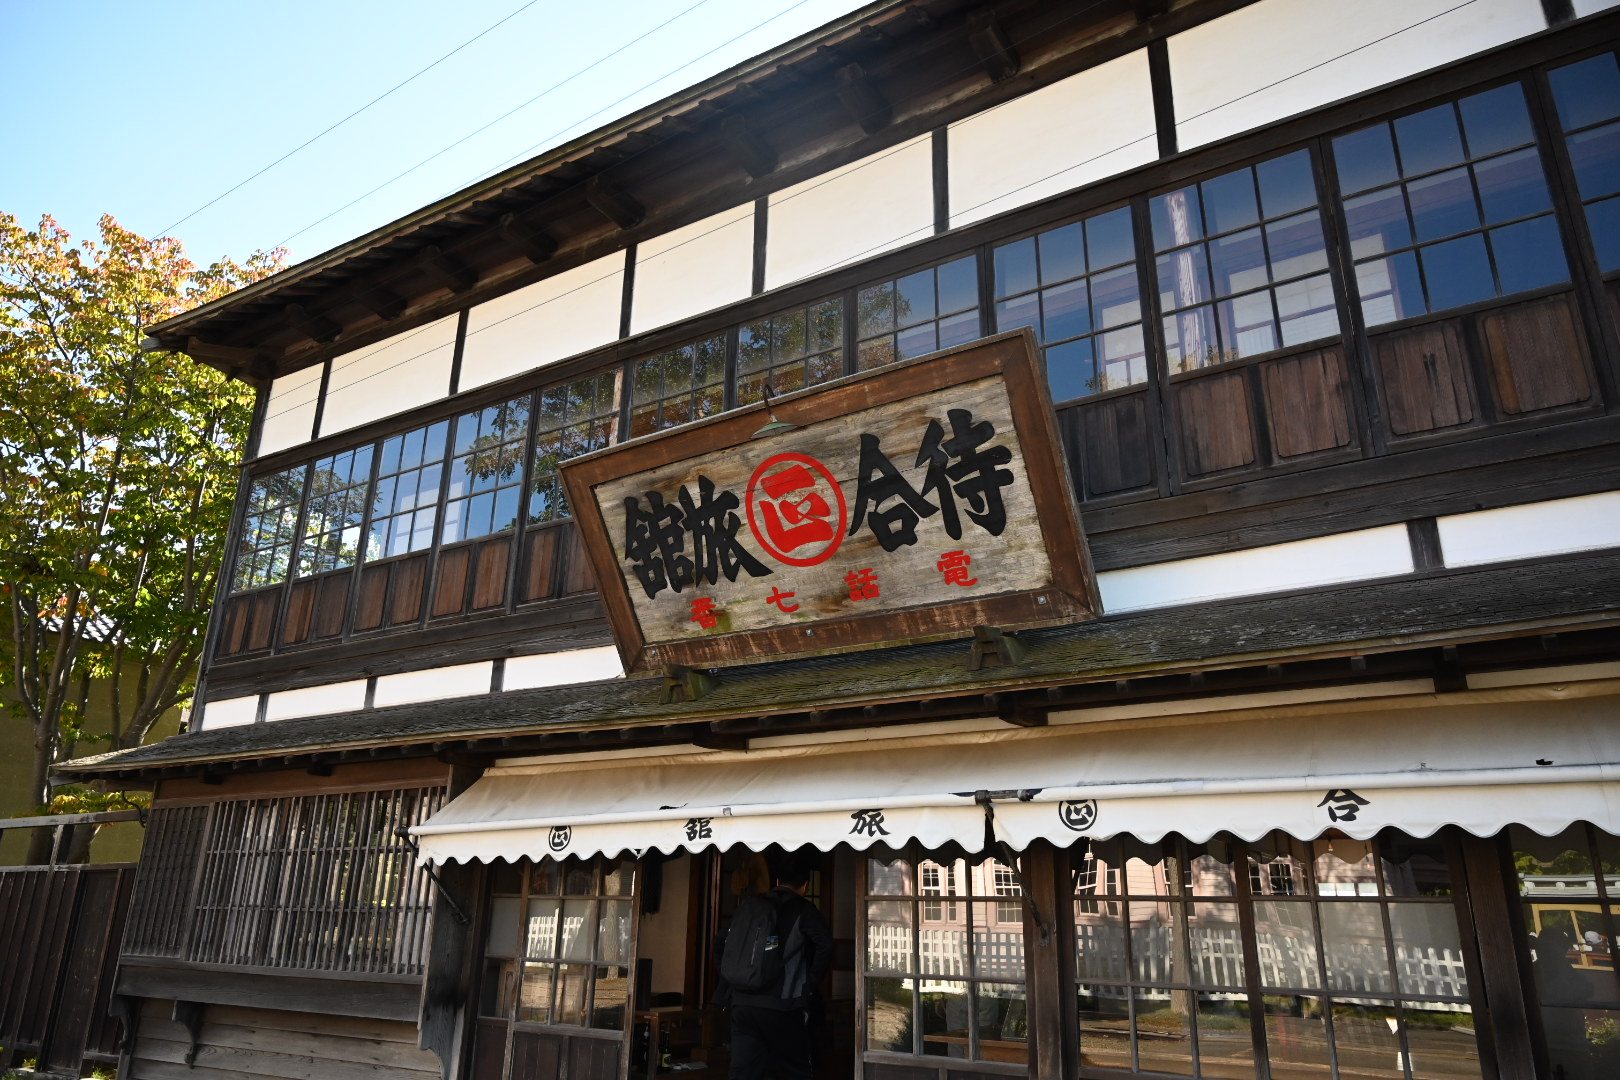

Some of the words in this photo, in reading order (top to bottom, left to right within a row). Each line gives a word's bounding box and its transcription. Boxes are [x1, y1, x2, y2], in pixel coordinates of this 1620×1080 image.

[624, 474, 775, 600] 旅館
[848, 408, 1015, 553] 待合
[1316, 788, 1371, 822] 合
